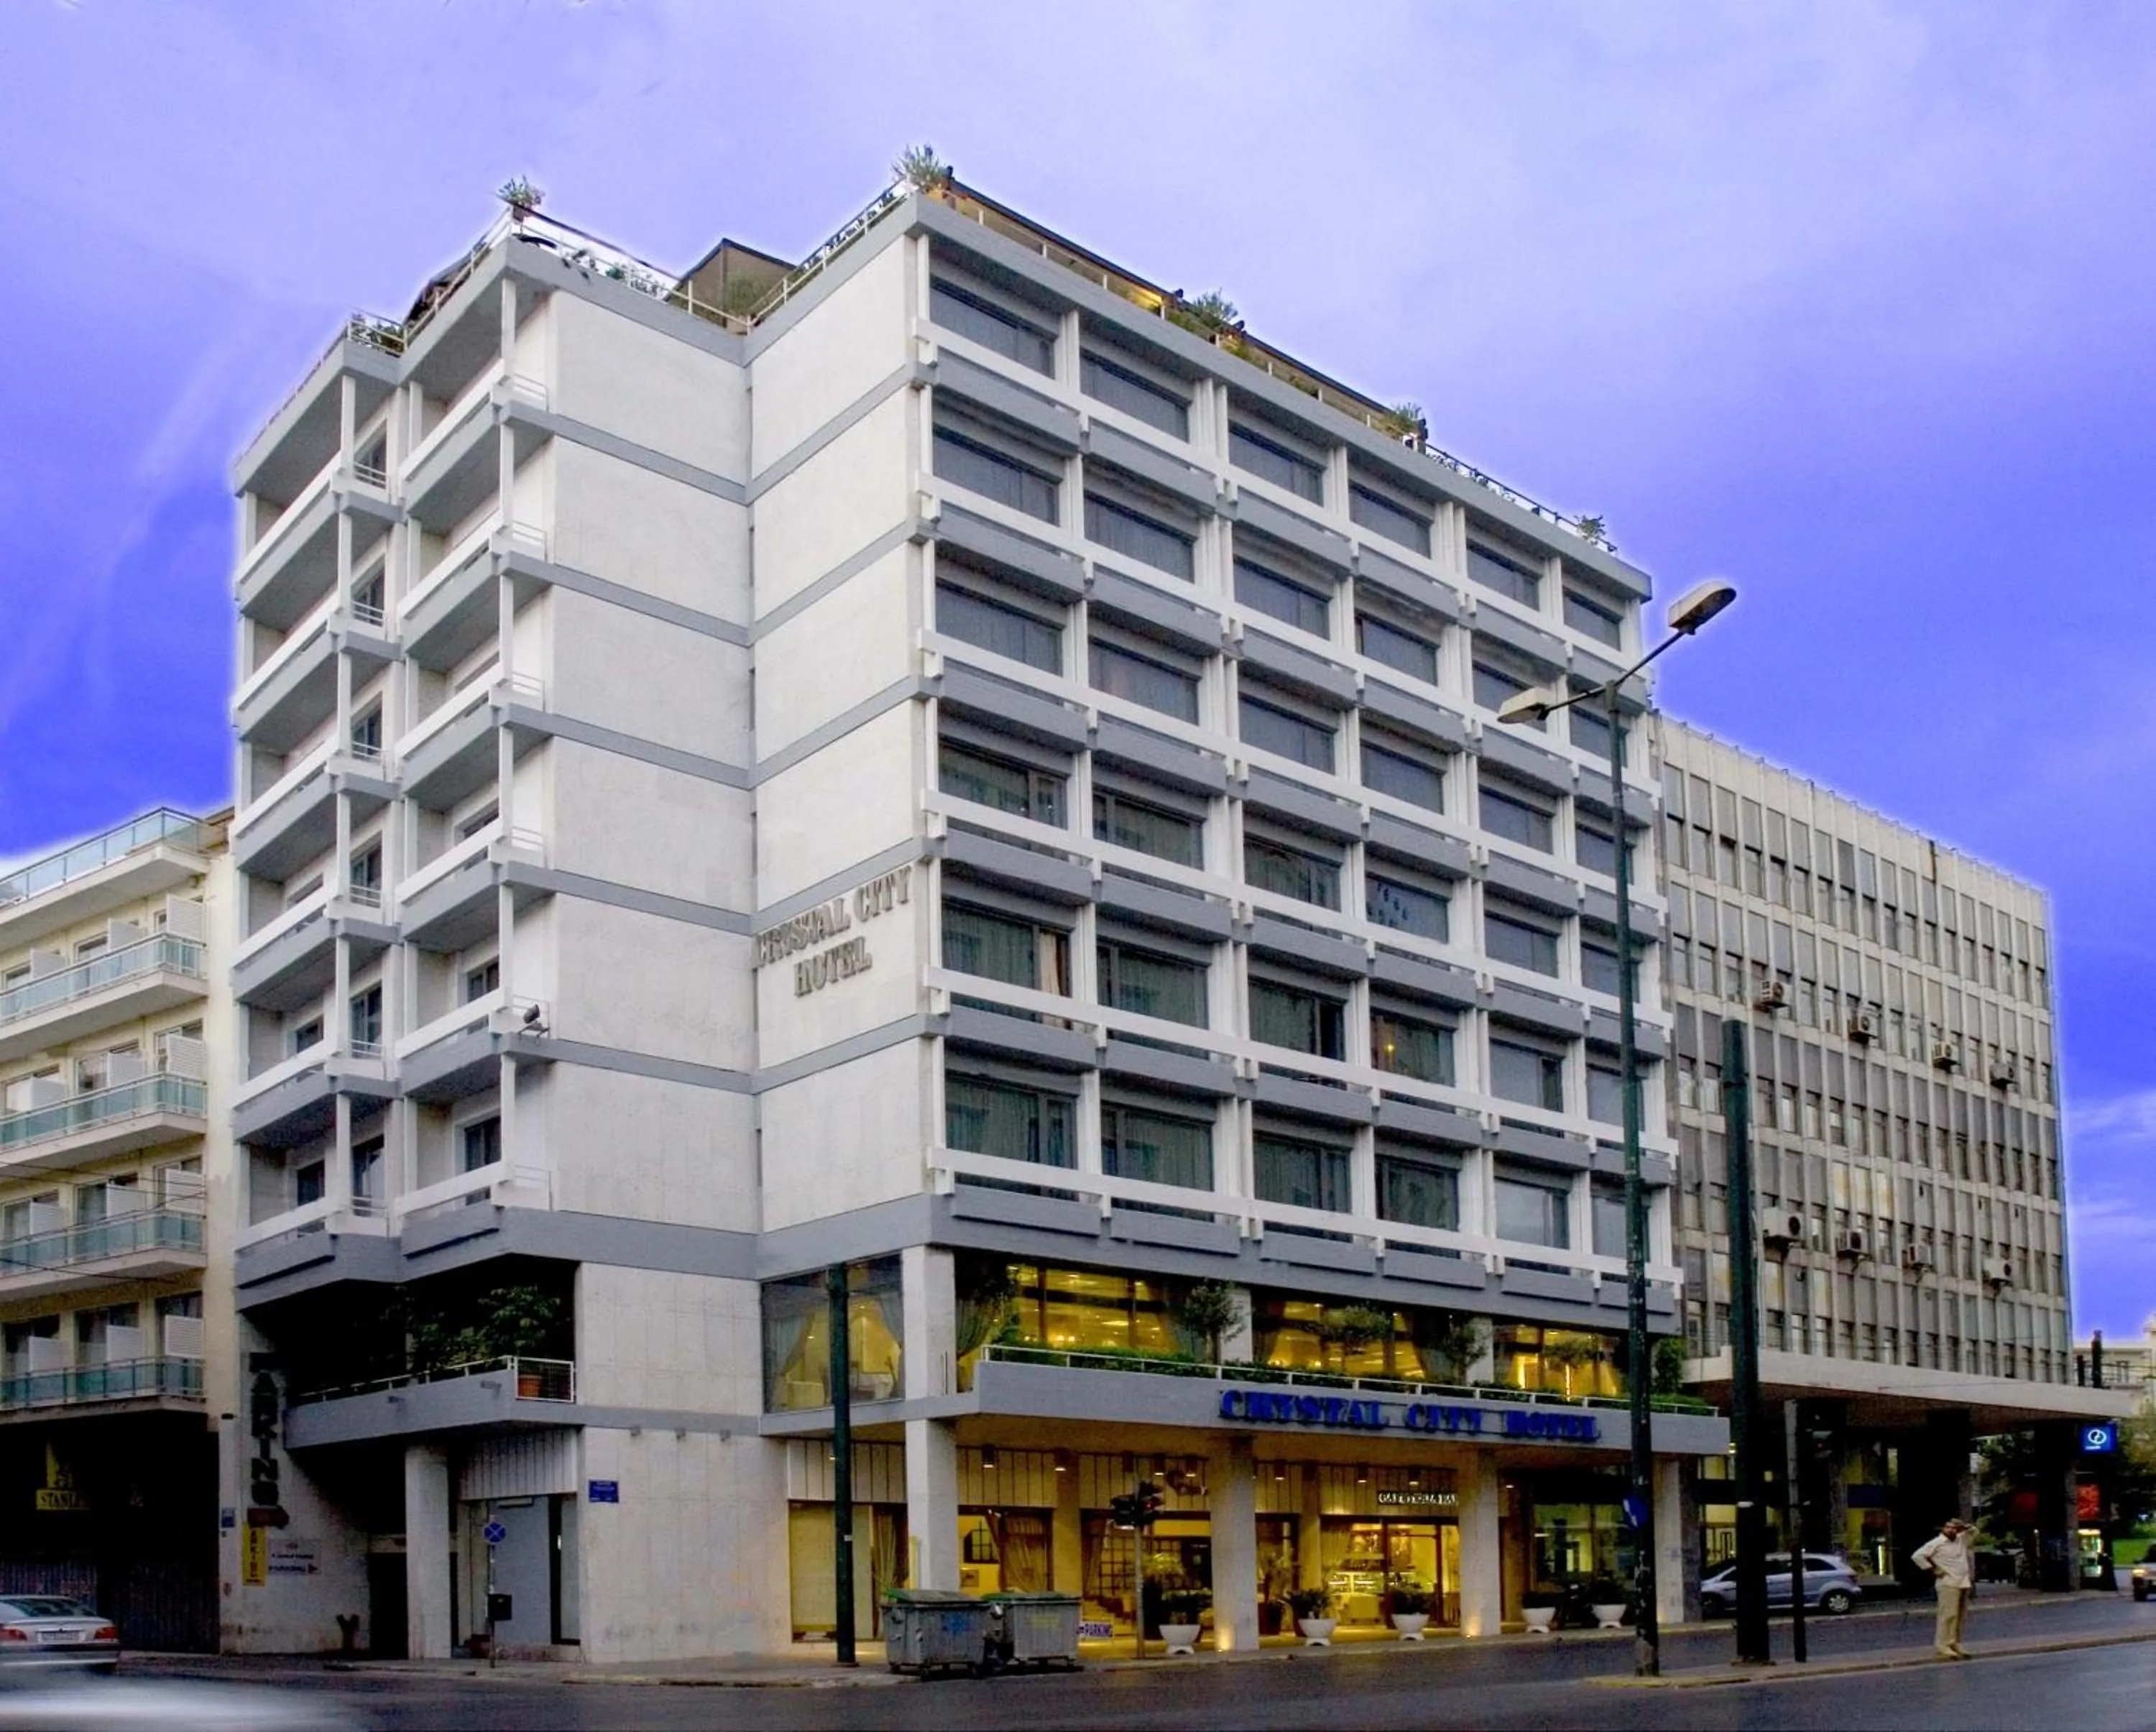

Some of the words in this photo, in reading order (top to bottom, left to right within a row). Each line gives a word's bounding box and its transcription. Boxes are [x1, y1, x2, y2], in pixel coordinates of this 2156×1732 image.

[752, 898, 851, 968] CRYSTAL
[853, 865, 912, 923] CITY
[793, 936, 872, 998] HOTEL
[1220, 1389, 1390, 1430] CRYSTAL
[1404, 1404, 1483, 1436] CITY
[1502, 1410, 1601, 1443] HOTEL
